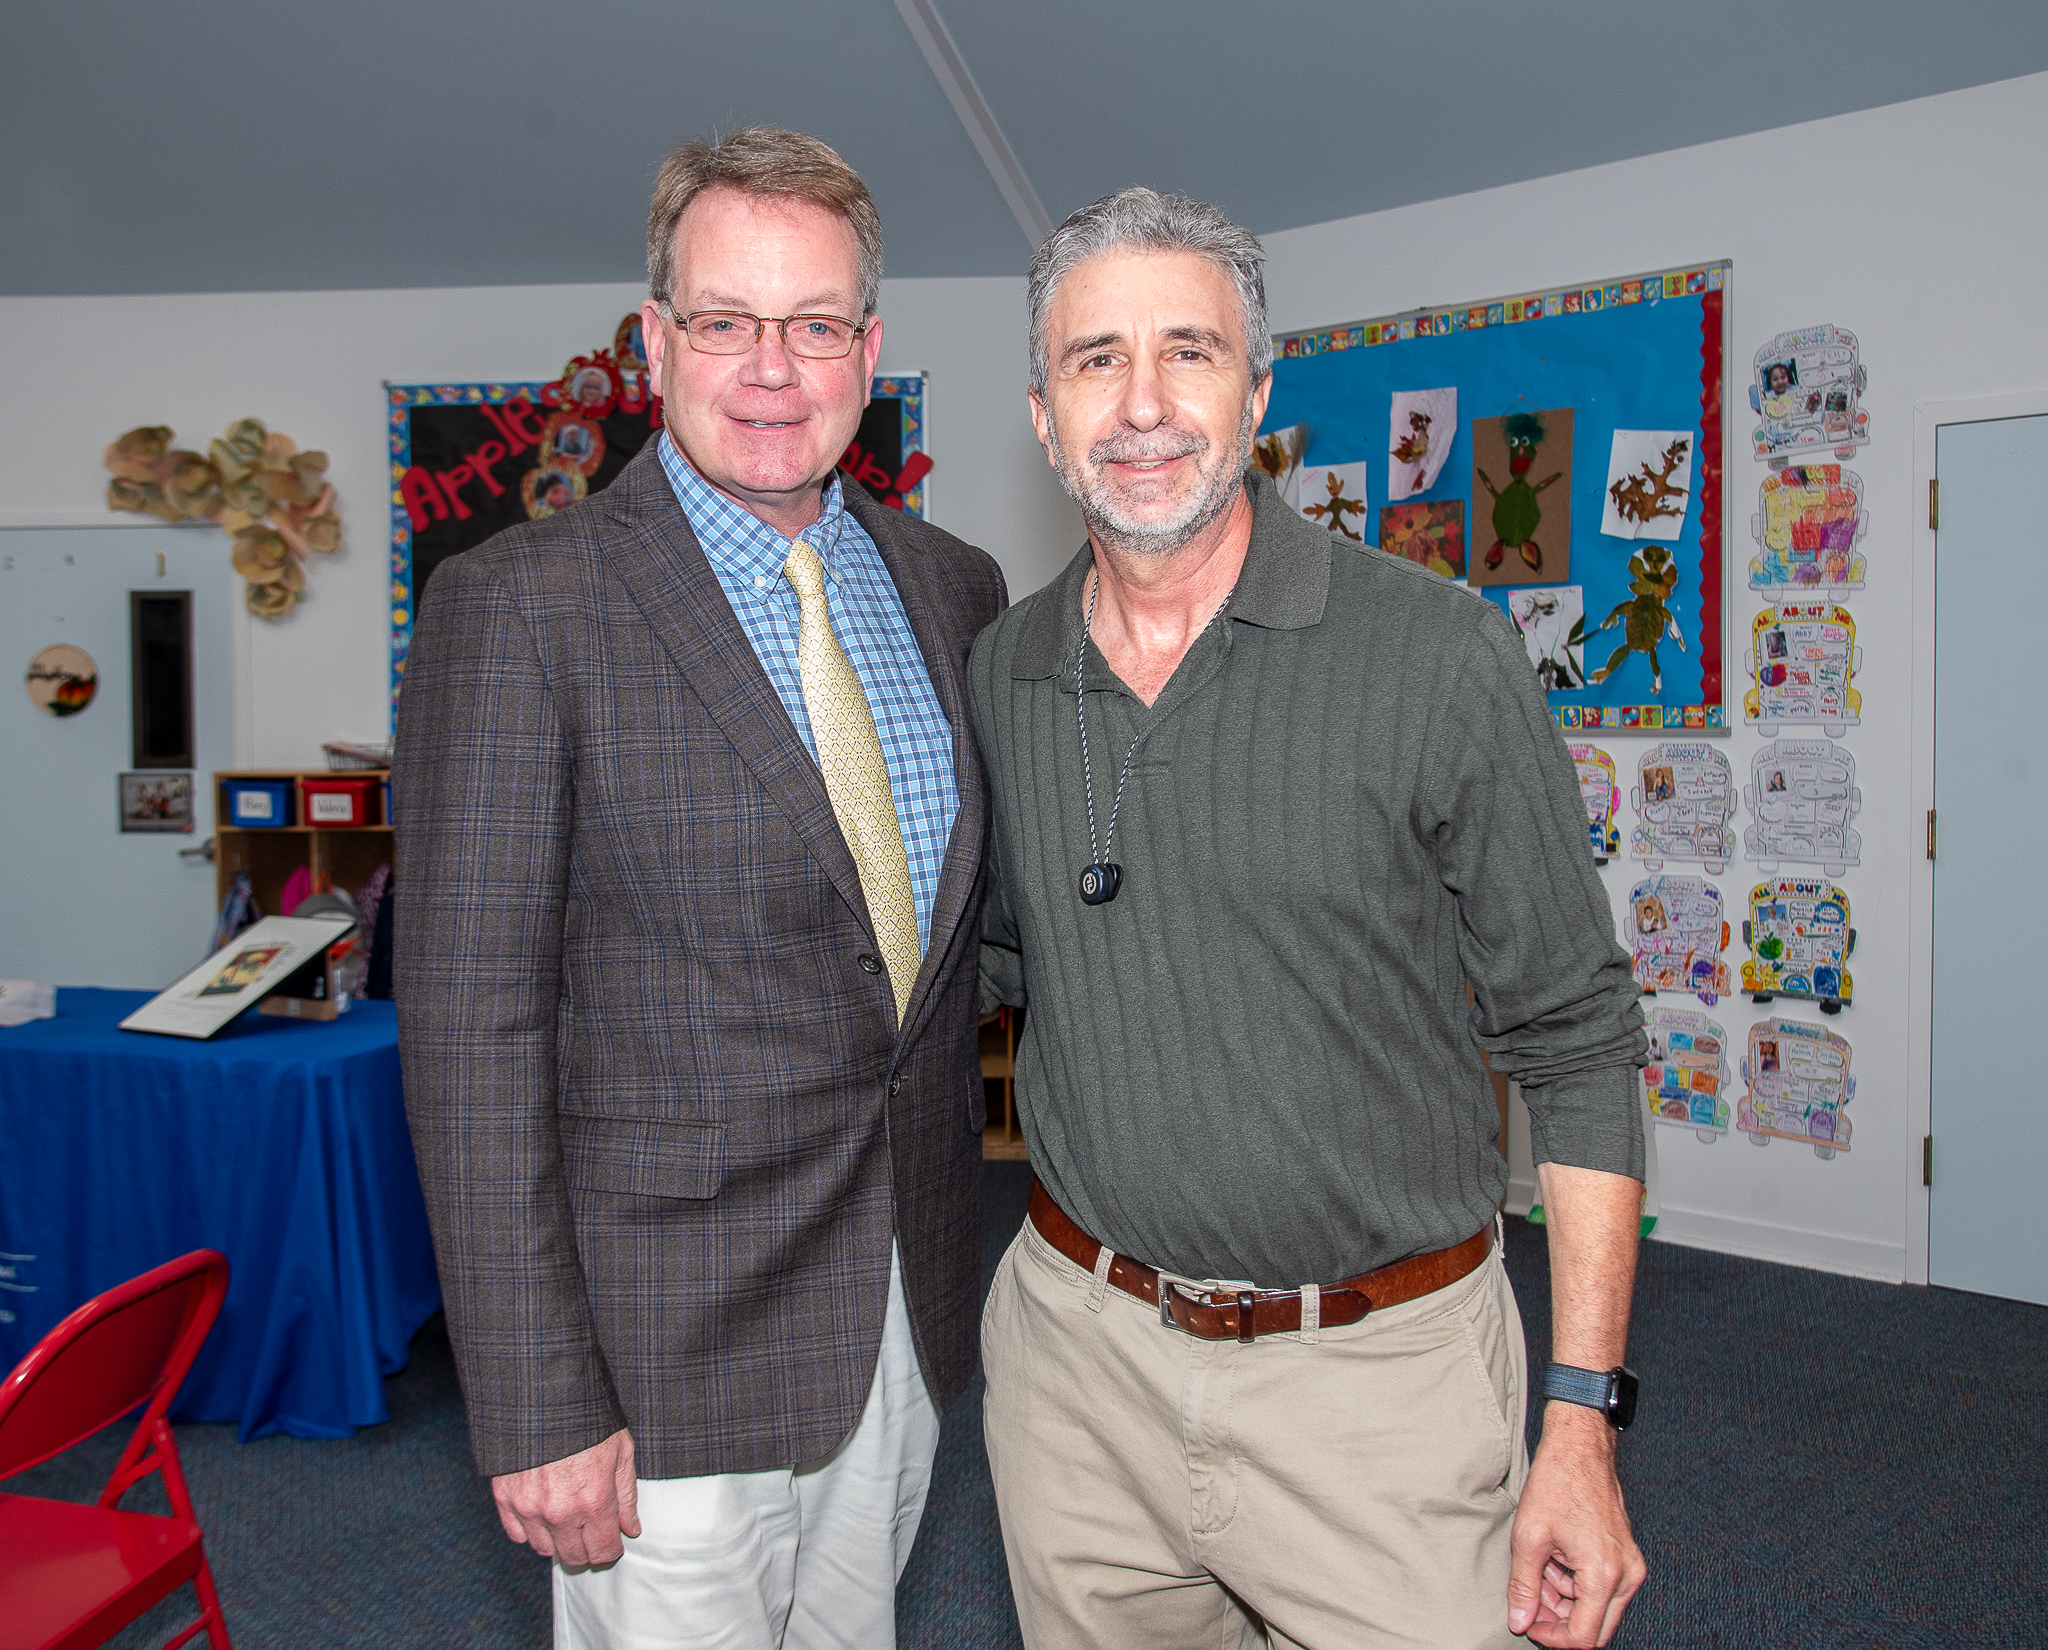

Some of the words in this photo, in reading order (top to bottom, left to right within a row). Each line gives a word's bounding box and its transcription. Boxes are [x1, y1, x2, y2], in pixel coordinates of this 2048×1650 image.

[837, 440, 934, 511] op!
[1782, 606, 1825, 617] ABOUT
[1834, 611, 1850, 625] ME
[1665, 748, 1706, 759] ABOUT
[1782, 744, 1825, 757] ABOUT
[1704, 888, 1718, 900] ME
[1753, 888, 1771, 900] ALL
[1779, 883, 1821, 895] ABOUT
[1832, 892, 1846, 905] ME
[1779, 1023, 1820, 1039] ABOUT
